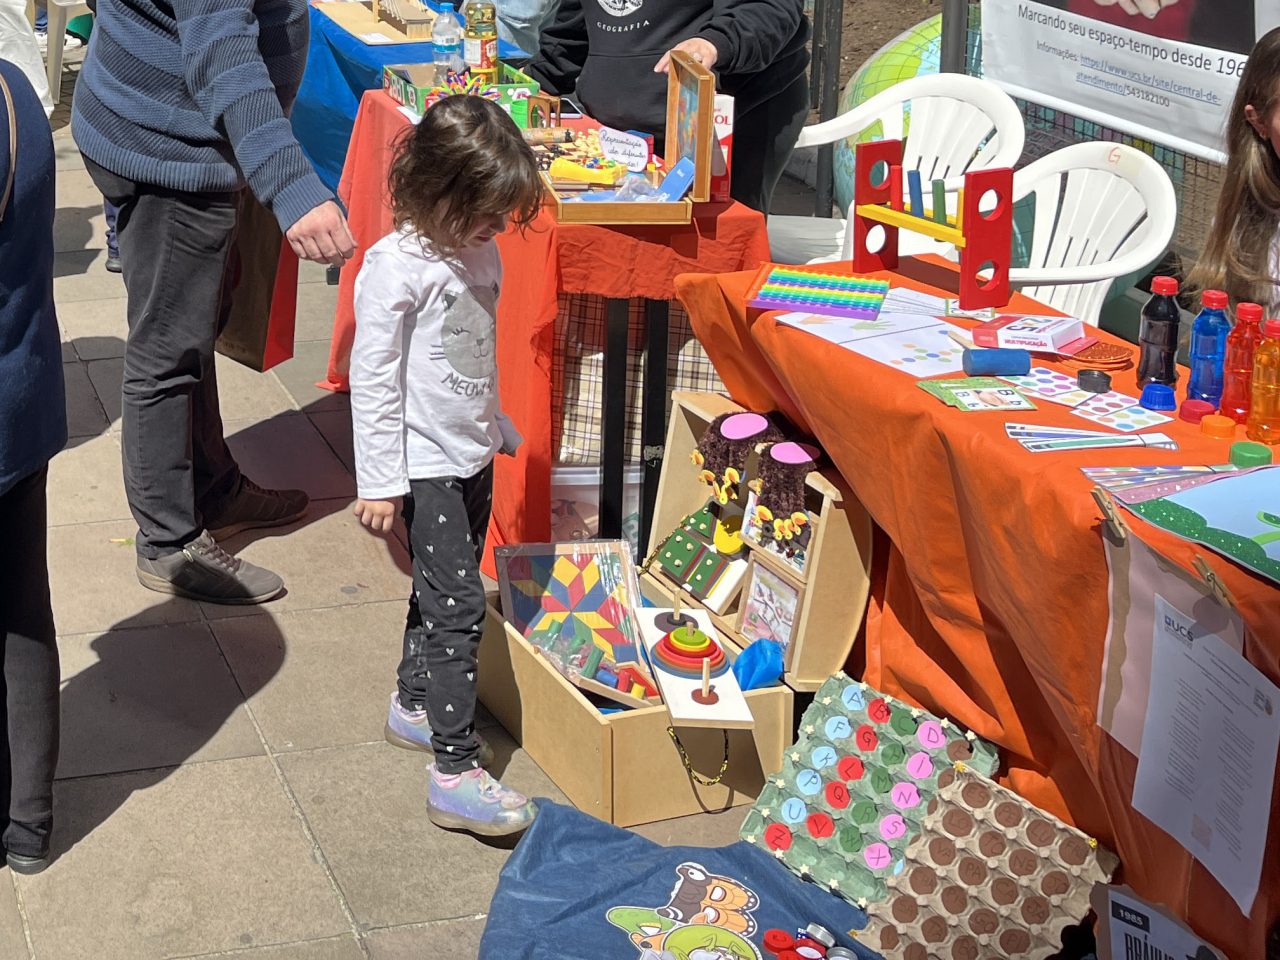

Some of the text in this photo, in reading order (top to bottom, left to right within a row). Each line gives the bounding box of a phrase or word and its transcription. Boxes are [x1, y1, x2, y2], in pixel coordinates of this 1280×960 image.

[597, 20, 650, 33] GEOGRAFIA
[1018, 3, 1067, 31] Marcando
[1068, 23, 1086, 37] seu
[1088, 27, 1168, 60] espaço-tempo
[1171, 48, 1212, 70] desde
[1172, 620, 1195, 642] UCS
[833, 722, 845, 733] F
[847, 691, 863, 706] A
[873, 704, 887, 720] B
[927, 728, 940, 743] D
[820, 753, 911, 804] K L M N
[804, 773, 819, 787] P
[834, 786, 844, 803] Q
[887, 821, 900, 835] S
[773, 827, 786, 847] Z
[788, 805, 802, 820] U
[813, 819, 825, 831] V
[871, 848, 887, 865] X
[1120, 910, 1143, 926] 1985
